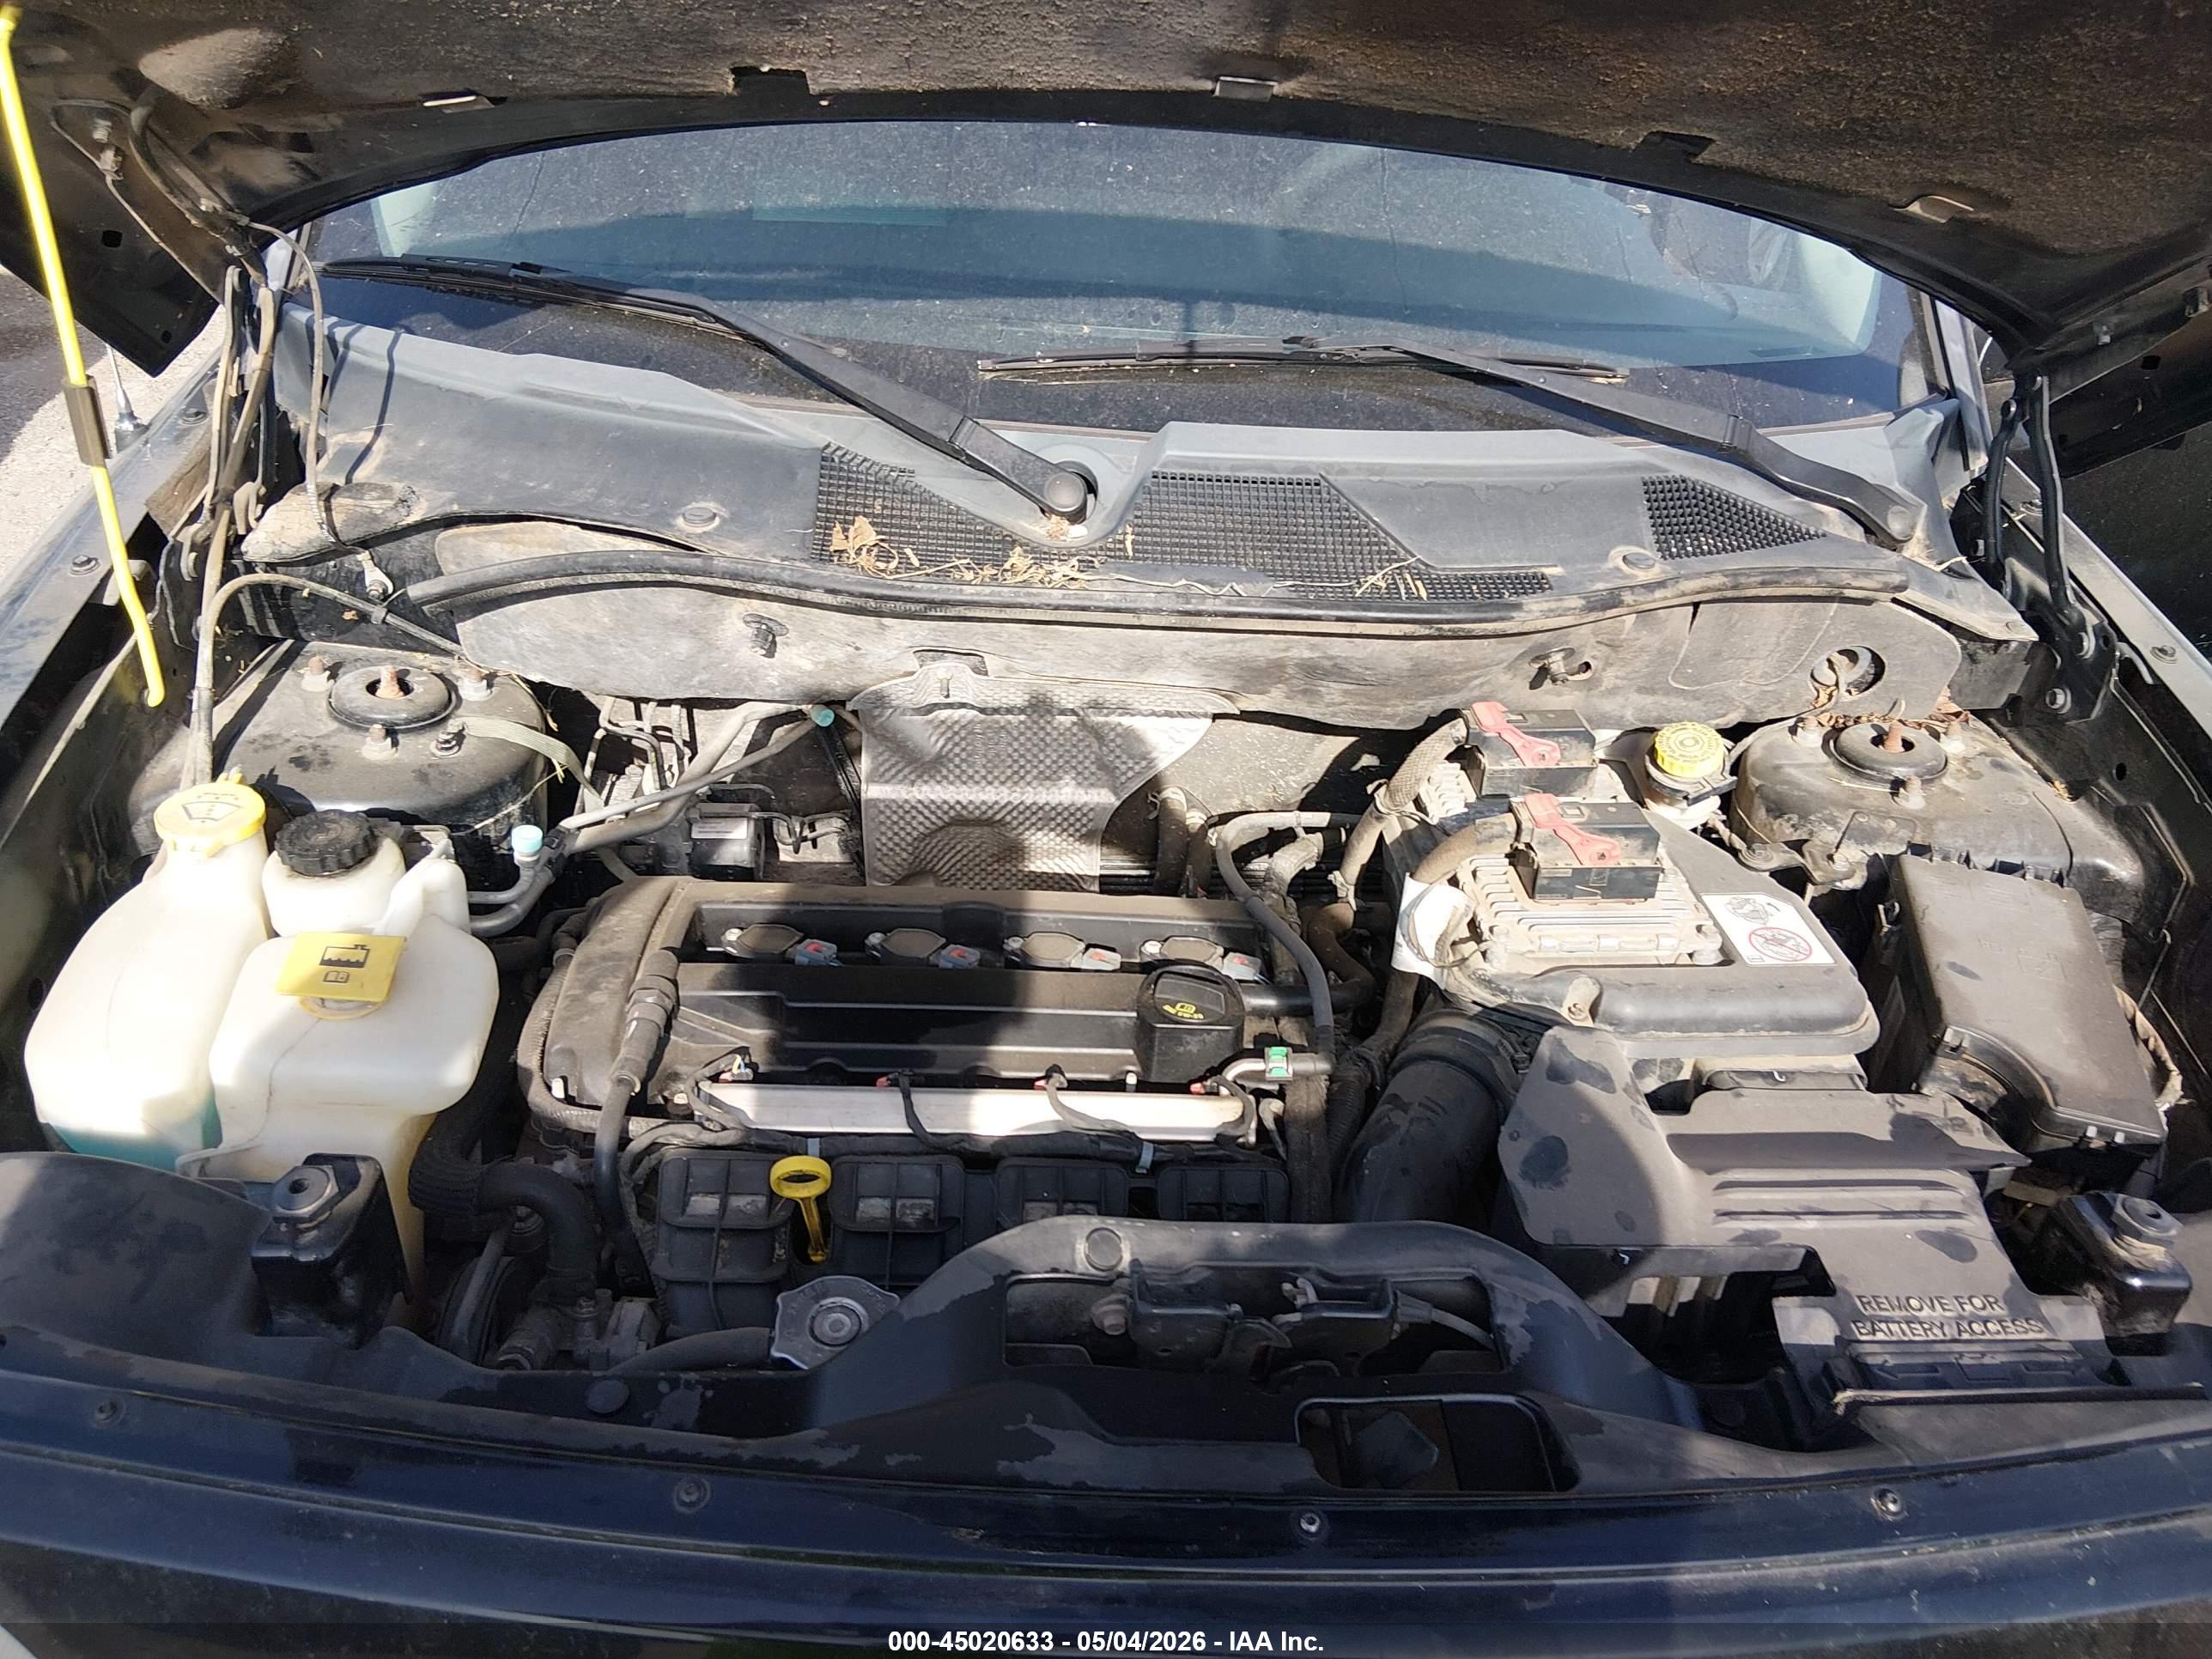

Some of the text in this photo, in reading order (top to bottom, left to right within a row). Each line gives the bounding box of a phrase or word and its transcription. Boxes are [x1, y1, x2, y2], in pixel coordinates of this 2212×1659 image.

[1855, 1293, 2005, 1313] REMOVE FOR
[1851, 1317, 2045, 1337] BATTERY ACCESS
